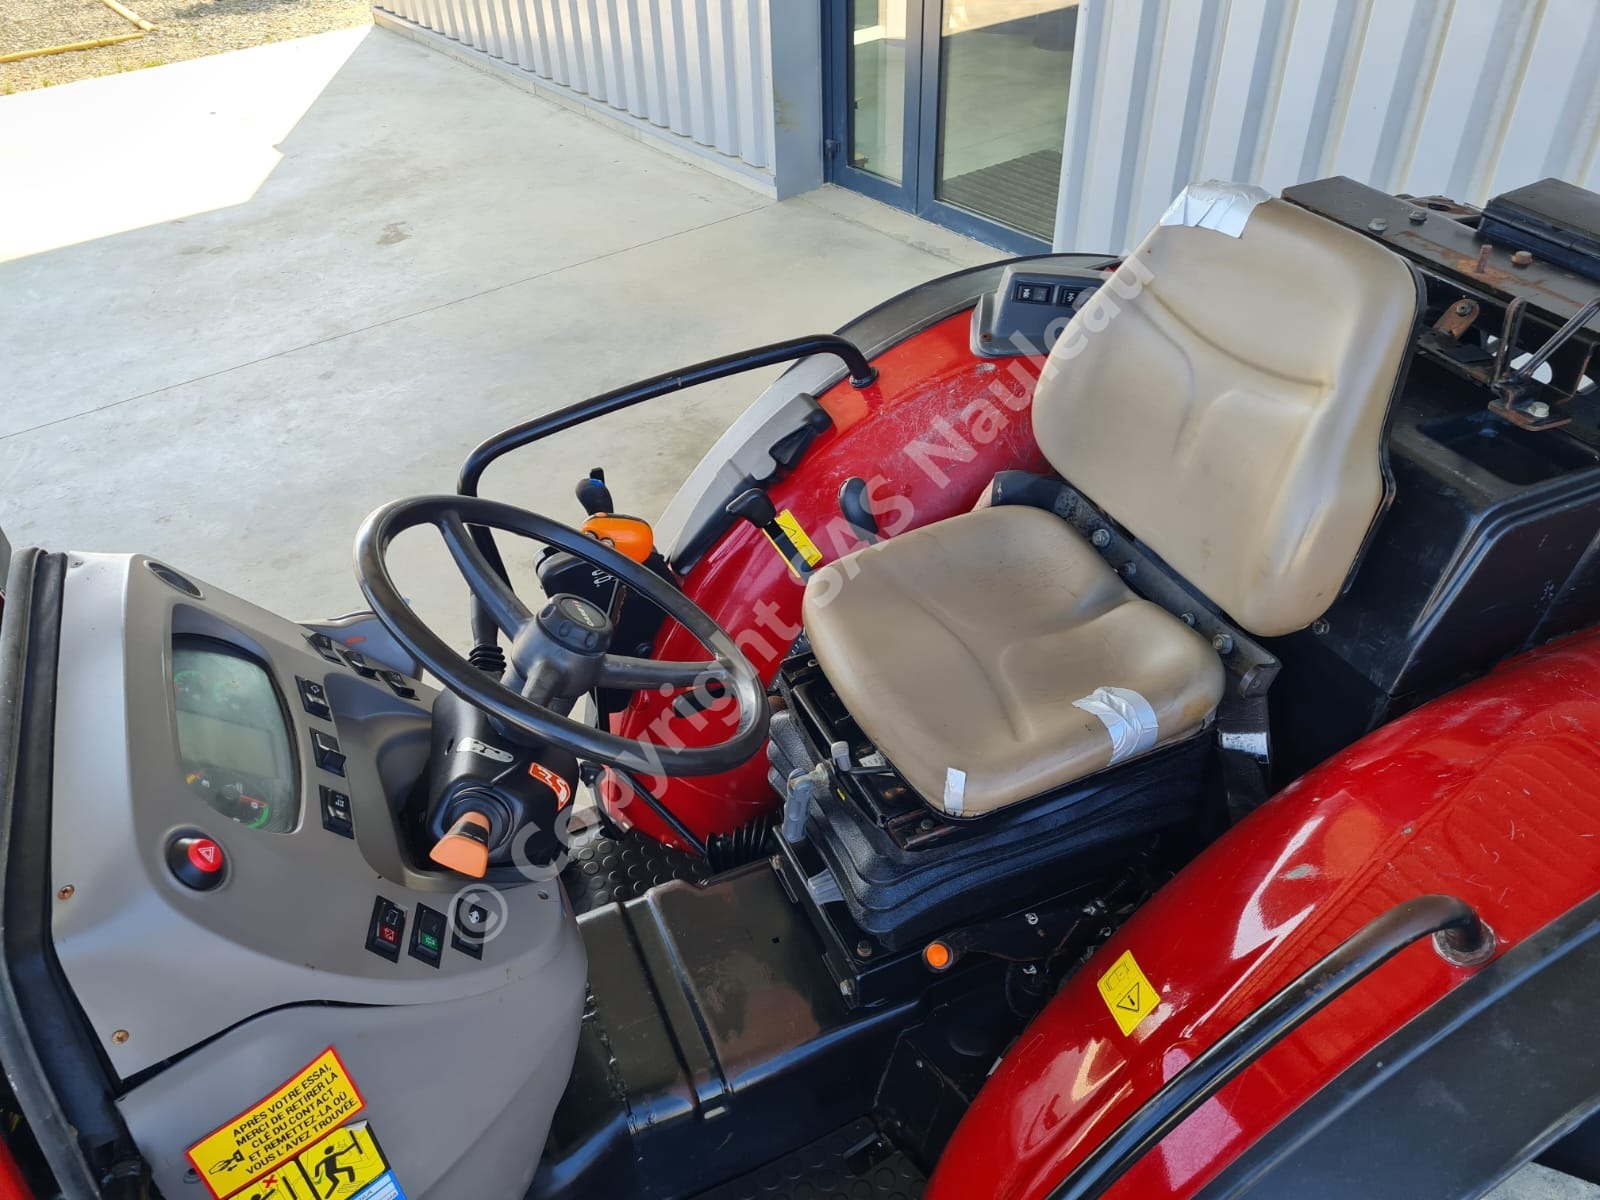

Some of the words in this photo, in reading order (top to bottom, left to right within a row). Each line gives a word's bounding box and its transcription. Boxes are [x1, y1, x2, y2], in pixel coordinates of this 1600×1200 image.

[233, 1111, 267, 1137] APRÈS
[267, 1085, 302, 1114] VOTRE
[301, 1063, 332, 1090] ESSAI,
[236, 1121, 270, 1146] MERCI
[270, 1112, 286, 1127] DE
[285, 1081, 326, 1115] RETIRER
[324, 1072, 338, 1085] LA
[246, 1154, 276, 1174] VOUS
[312, 1097, 358, 1133] TROUVÉE.
[248, 1150, 262, 1162] ET
[333, 1091, 347, 1106] OÙ
[251, 1131, 272, 1149] CLÉ
[272, 1122, 288, 1136] DU
[288, 1088, 334, 1125] CONTACT
